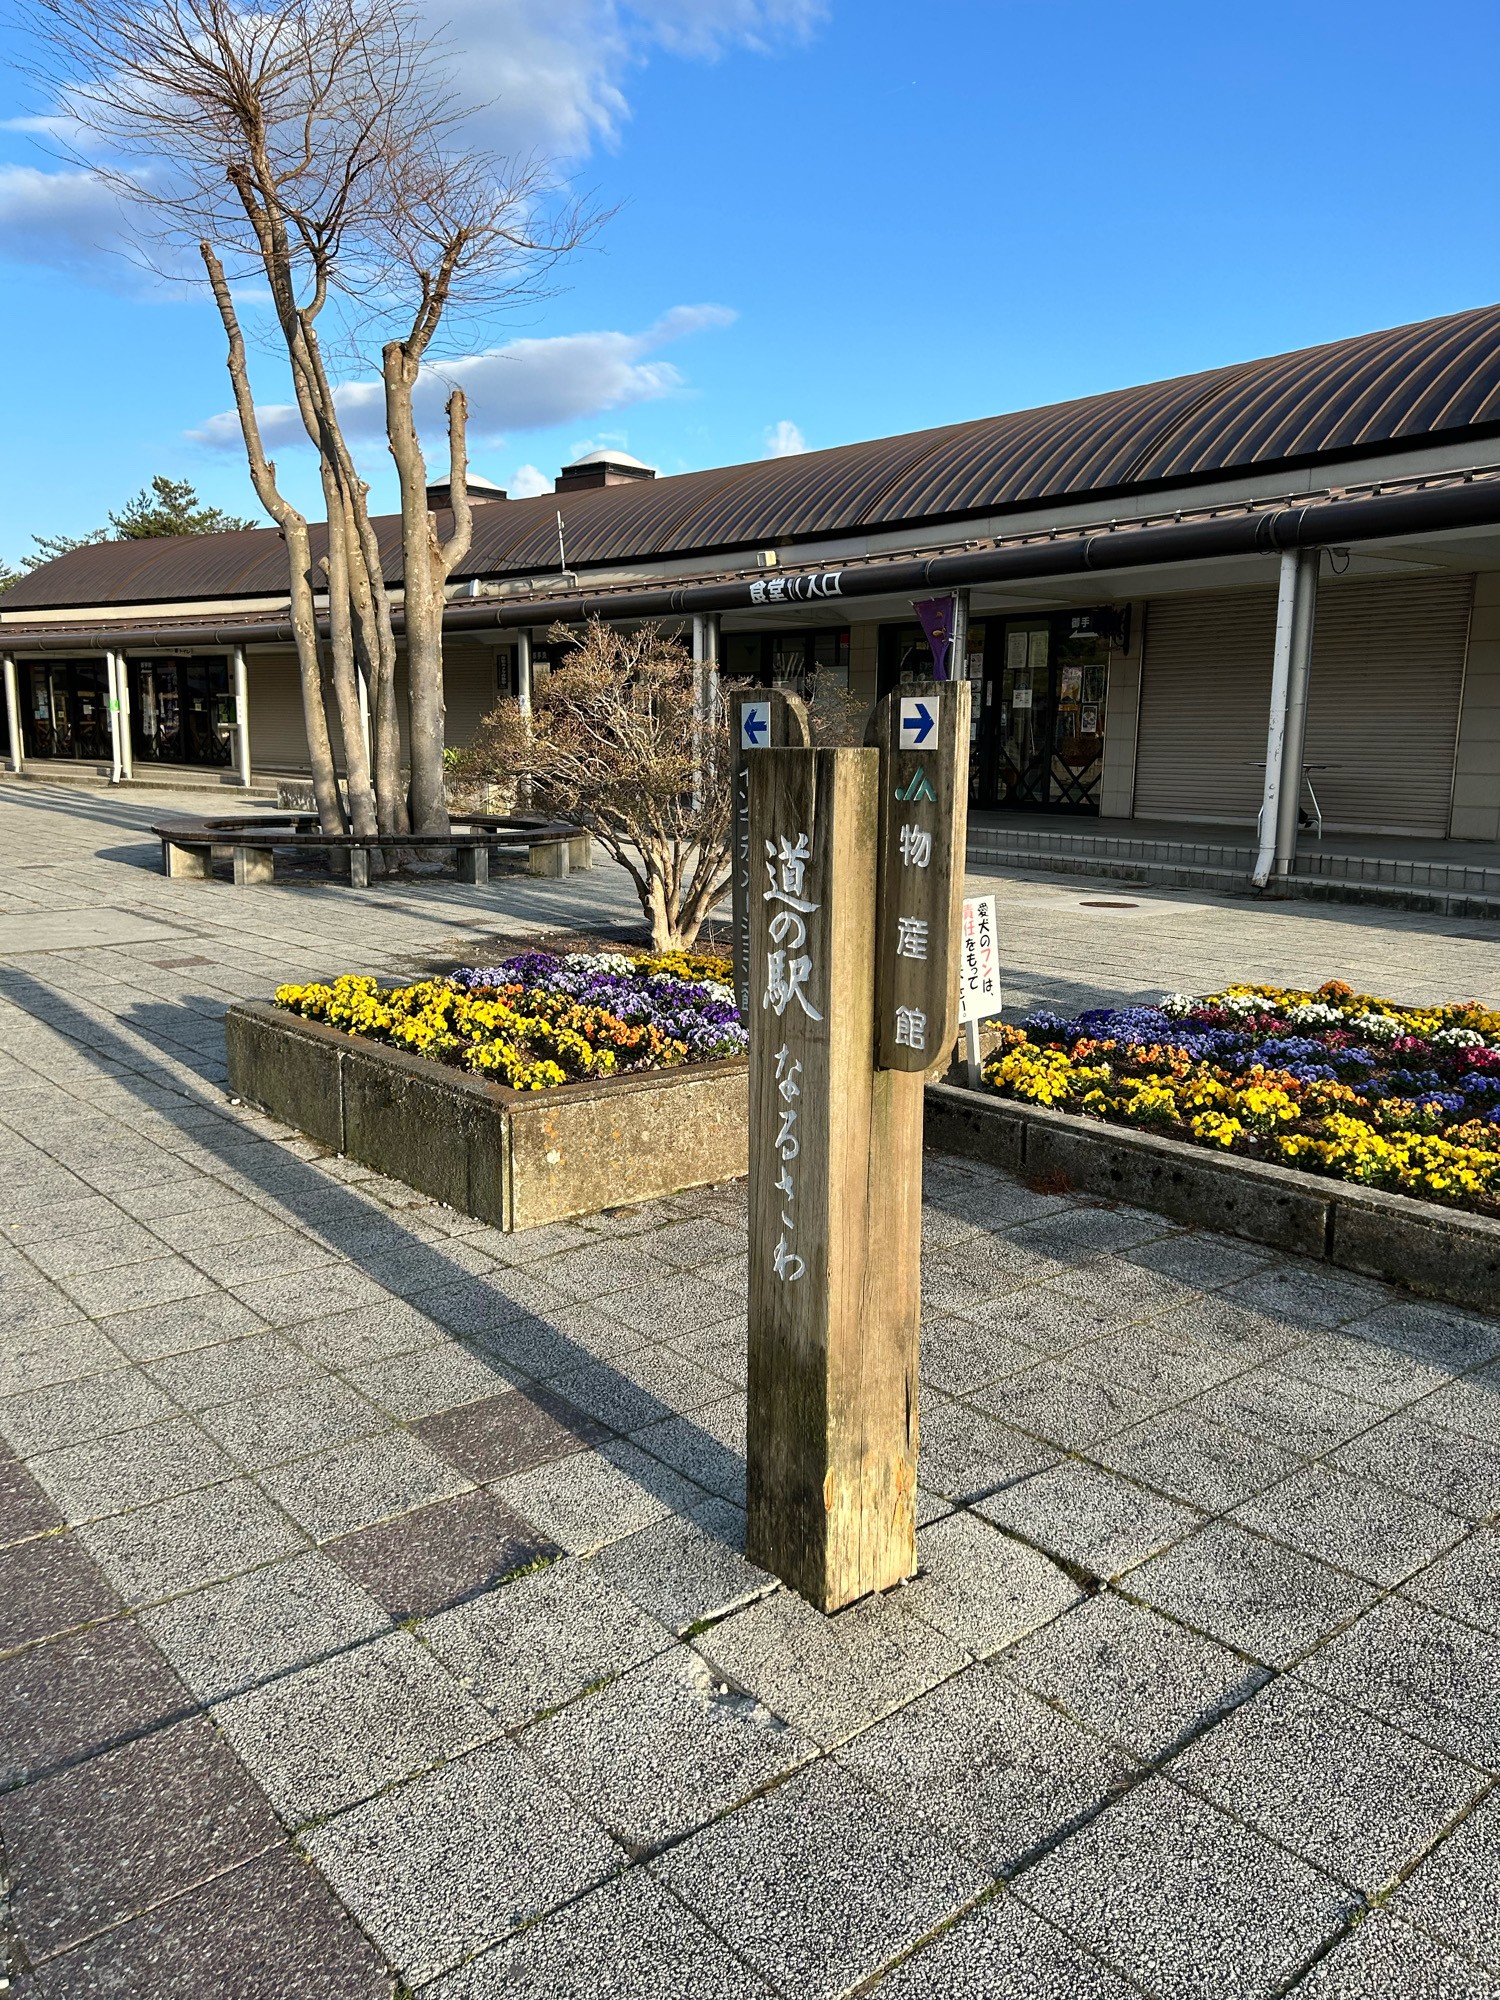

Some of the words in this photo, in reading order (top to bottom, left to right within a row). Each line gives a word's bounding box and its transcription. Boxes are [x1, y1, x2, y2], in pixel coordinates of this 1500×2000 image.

[749, 577, 789, 604] 食堂
[806, 571, 843, 599] 入口
[763, 832, 824, 1021] 道の駅
[895, 823, 932, 1050] 物産館
[963, 903, 979, 990] 責任をもって
[977, 902, 994, 997] 愛犬のフンは、
[773, 1042, 806, 1281] なるさわ
